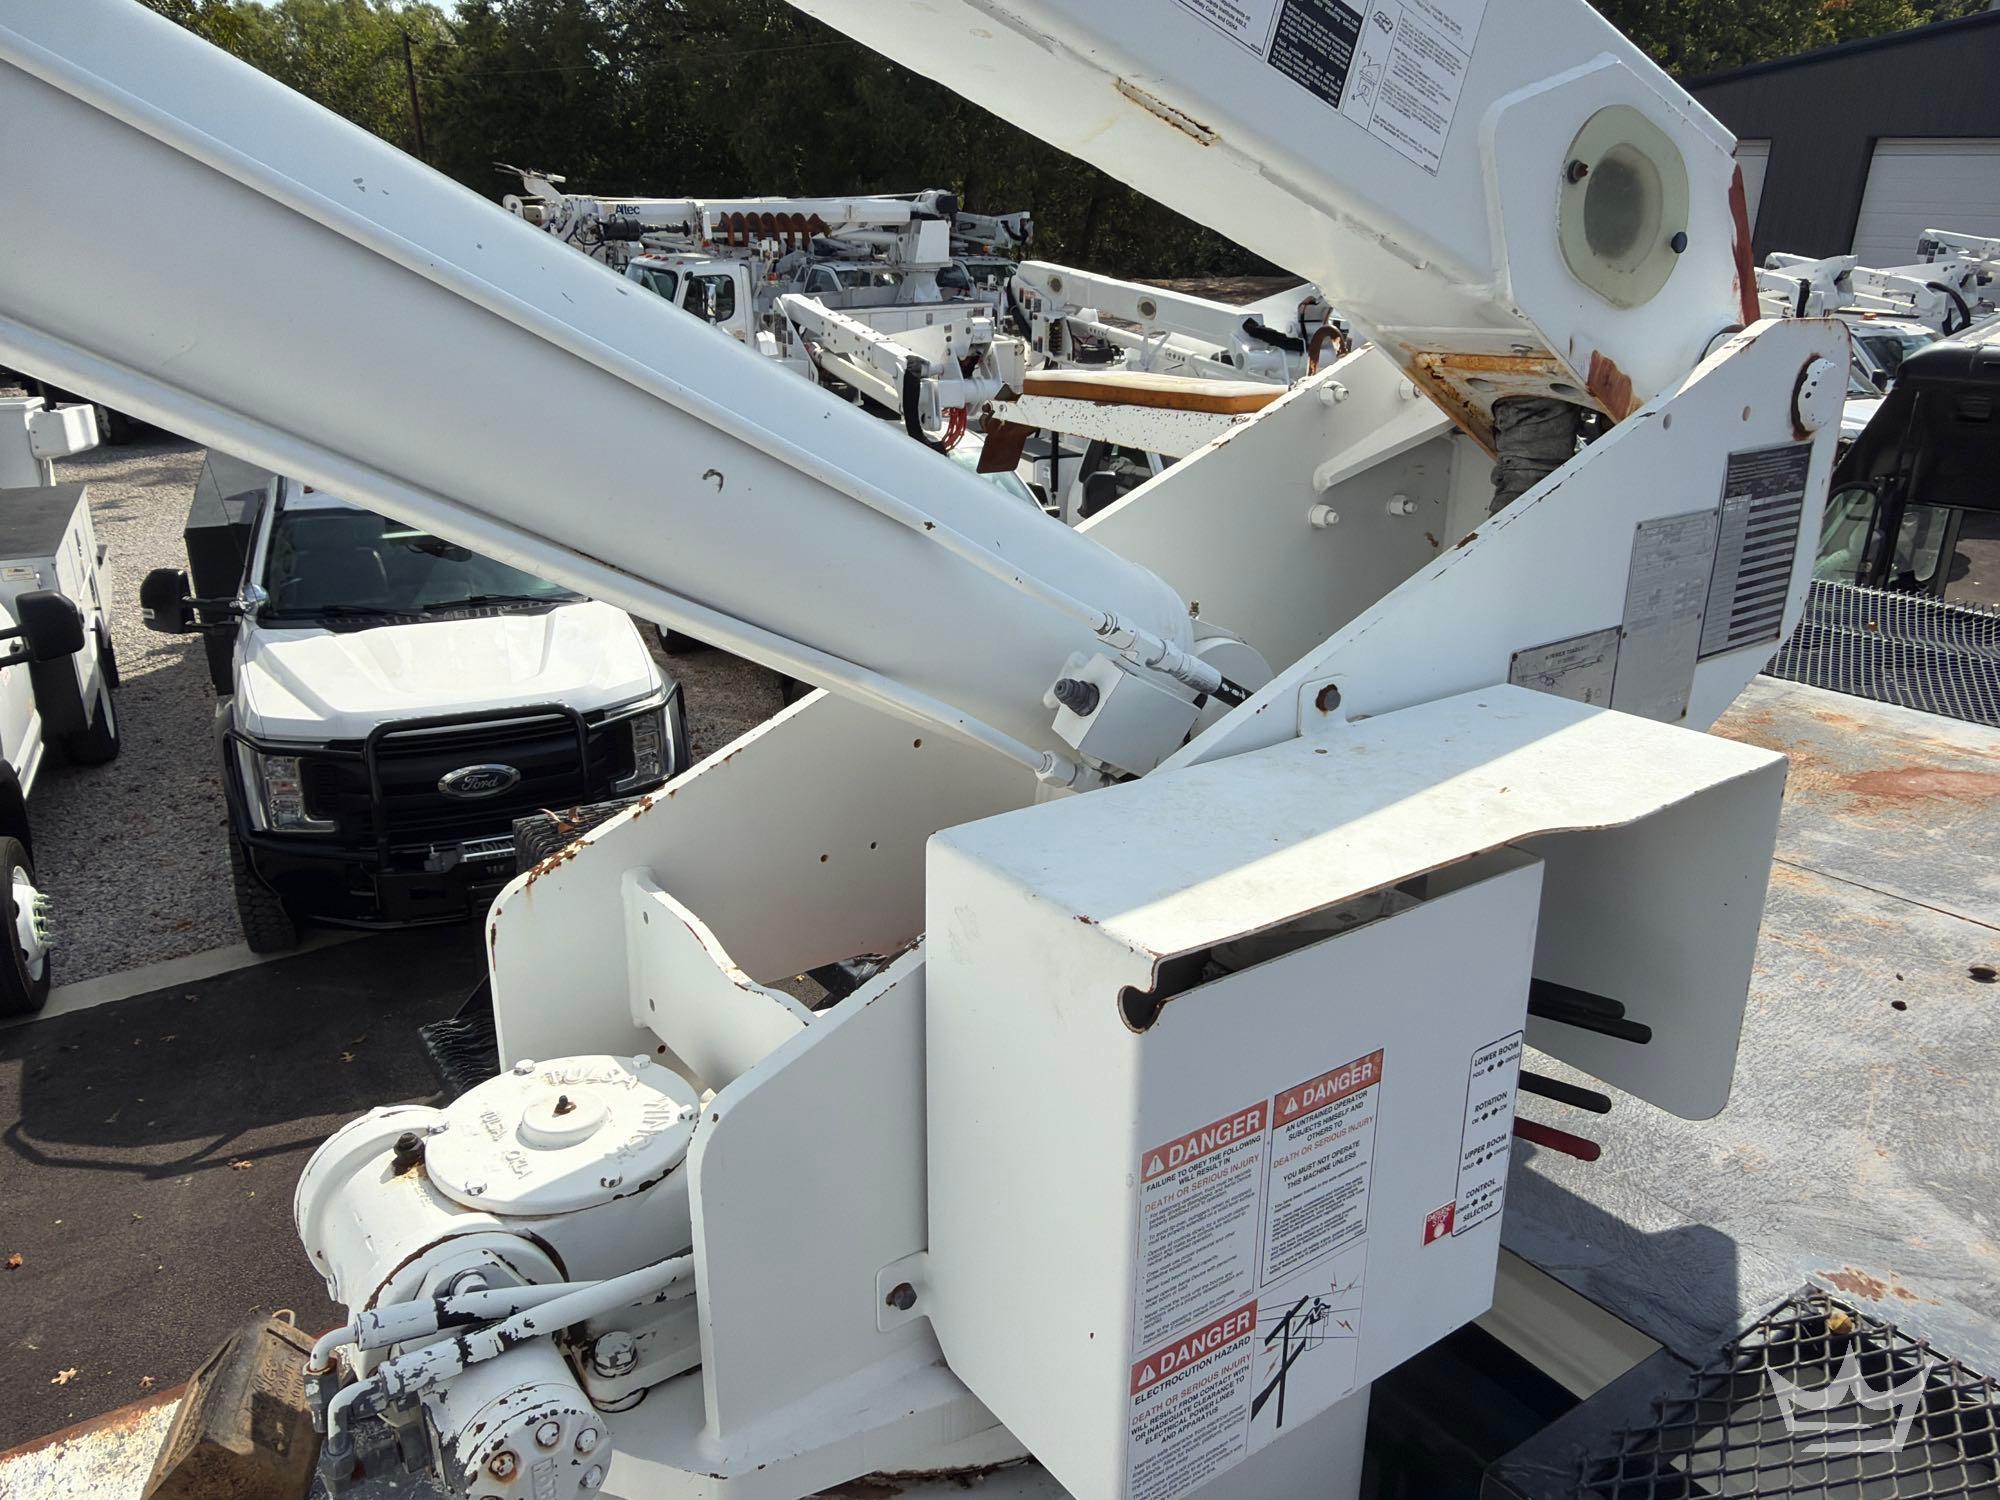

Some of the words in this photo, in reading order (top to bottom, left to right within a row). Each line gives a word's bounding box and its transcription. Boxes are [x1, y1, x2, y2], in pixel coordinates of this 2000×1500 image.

[615, 204, 640, 215] Altec
[461, 774, 498, 790] Ford
[1474, 1050, 1496, 1066] LOWER
[1498, 1040, 1518, 1055] BOOM
[1303, 1061, 1372, 1106] DANGER
[1474, 1090, 1507, 1112] ROTATION
[1285, 1123, 1294, 1133] AN
[1296, 1106, 1332, 1128] UNTRAINED
[1333, 1089, 1367, 1111] OPERATOR
[1288, 1120, 1321, 1141] SUBJECTS
[1322, 1107, 1349, 1125] HIMSELF
[1350, 1100, 1363, 1112] AND
[1307, 1124, 1332, 1142] OTHERS
[1334, 1119, 1342, 1129] TO
[1169, 1110, 1259, 1166] DANGER
[1273, 1150, 1298, 1169] DEATH
[1301, 1144, 1312, 1155] OR
[1314, 1127, 1346, 1149] SERIOUS
[1348, 1114, 1373, 1133] INJURY
[1464, 1144, 1484, 1160] UPPER
[1486, 1133, 1506, 1148] BOOM
[1146, 1173, 1174, 1192] FAILURE
[1178, 1168, 1186, 1177] TO
[1188, 1159, 1206, 1173] OBEY
[1208, 1152, 1221, 1163] THE
[1223, 1135, 1260, 1157] FOLLOWING
[1178, 1173, 1194, 1185] WILL
[1196, 1160, 1221, 1177] RESULT
[1223, 1156, 1230, 1165] IN
[1283, 1170, 1296, 1182] YOU
[1298, 1161, 1314, 1174] MUST
[1317, 1154, 1329, 1165] NOT
[1331, 1139, 1359, 1158] OPERATE
[1287, 1177, 1301, 1189] THIS
[1303, 1162, 1330, 1182] MACHINE
[1332, 1150, 1356, 1167] UNLESS
[1144, 1192, 1174, 1213] DEATH
[1176, 1185, 1188, 1198] OR
[1191, 1167, 1228, 1192] SERIOUS
[1230, 1153, 1259, 1173] INJURY
[1465, 1177, 1496, 1198] CONTROL
[1463, 1200, 1492, 1221] SELECTOR
[1160, 1310, 1250, 1374] DANGER
[1132, 1402, 1162, 1426] DEATH
[1165, 1393, 1178, 1407] OR
[1180, 1370, 1218, 1399] SERIOUS
[1221, 1352, 1251, 1376] INJURY
[1135, 1356, 1211, 1405] ELECTROCUTION
[1214, 1335, 1250, 1361] HAZARD
[1131, 1420, 1148, 1436] WILL
[1150, 1404, 1176, 1425] RESULT
[1179, 1392, 1198, 1409] FROM
[1200, 1374, 1230, 1397] CONTACT
[1233, 1364, 1249, 1378] WITH
[1135, 1430, 1145, 1442] OR
[1147, 1404, 1191, 1435] INADEQUATE
[1193, 1380, 1232, 1408] CLEARANCE
[1236, 1374, 1244, 1384] TO
[1145, 1414, 1187, 1444] ELECTRICAL
[1189, 1399, 1213, 1419] POWER
[1215, 1387, 1234, 1404] LINES
[1161, 1430, 1175, 1444] AND
[1177, 1406, 1217, 1434] APPARATUS
